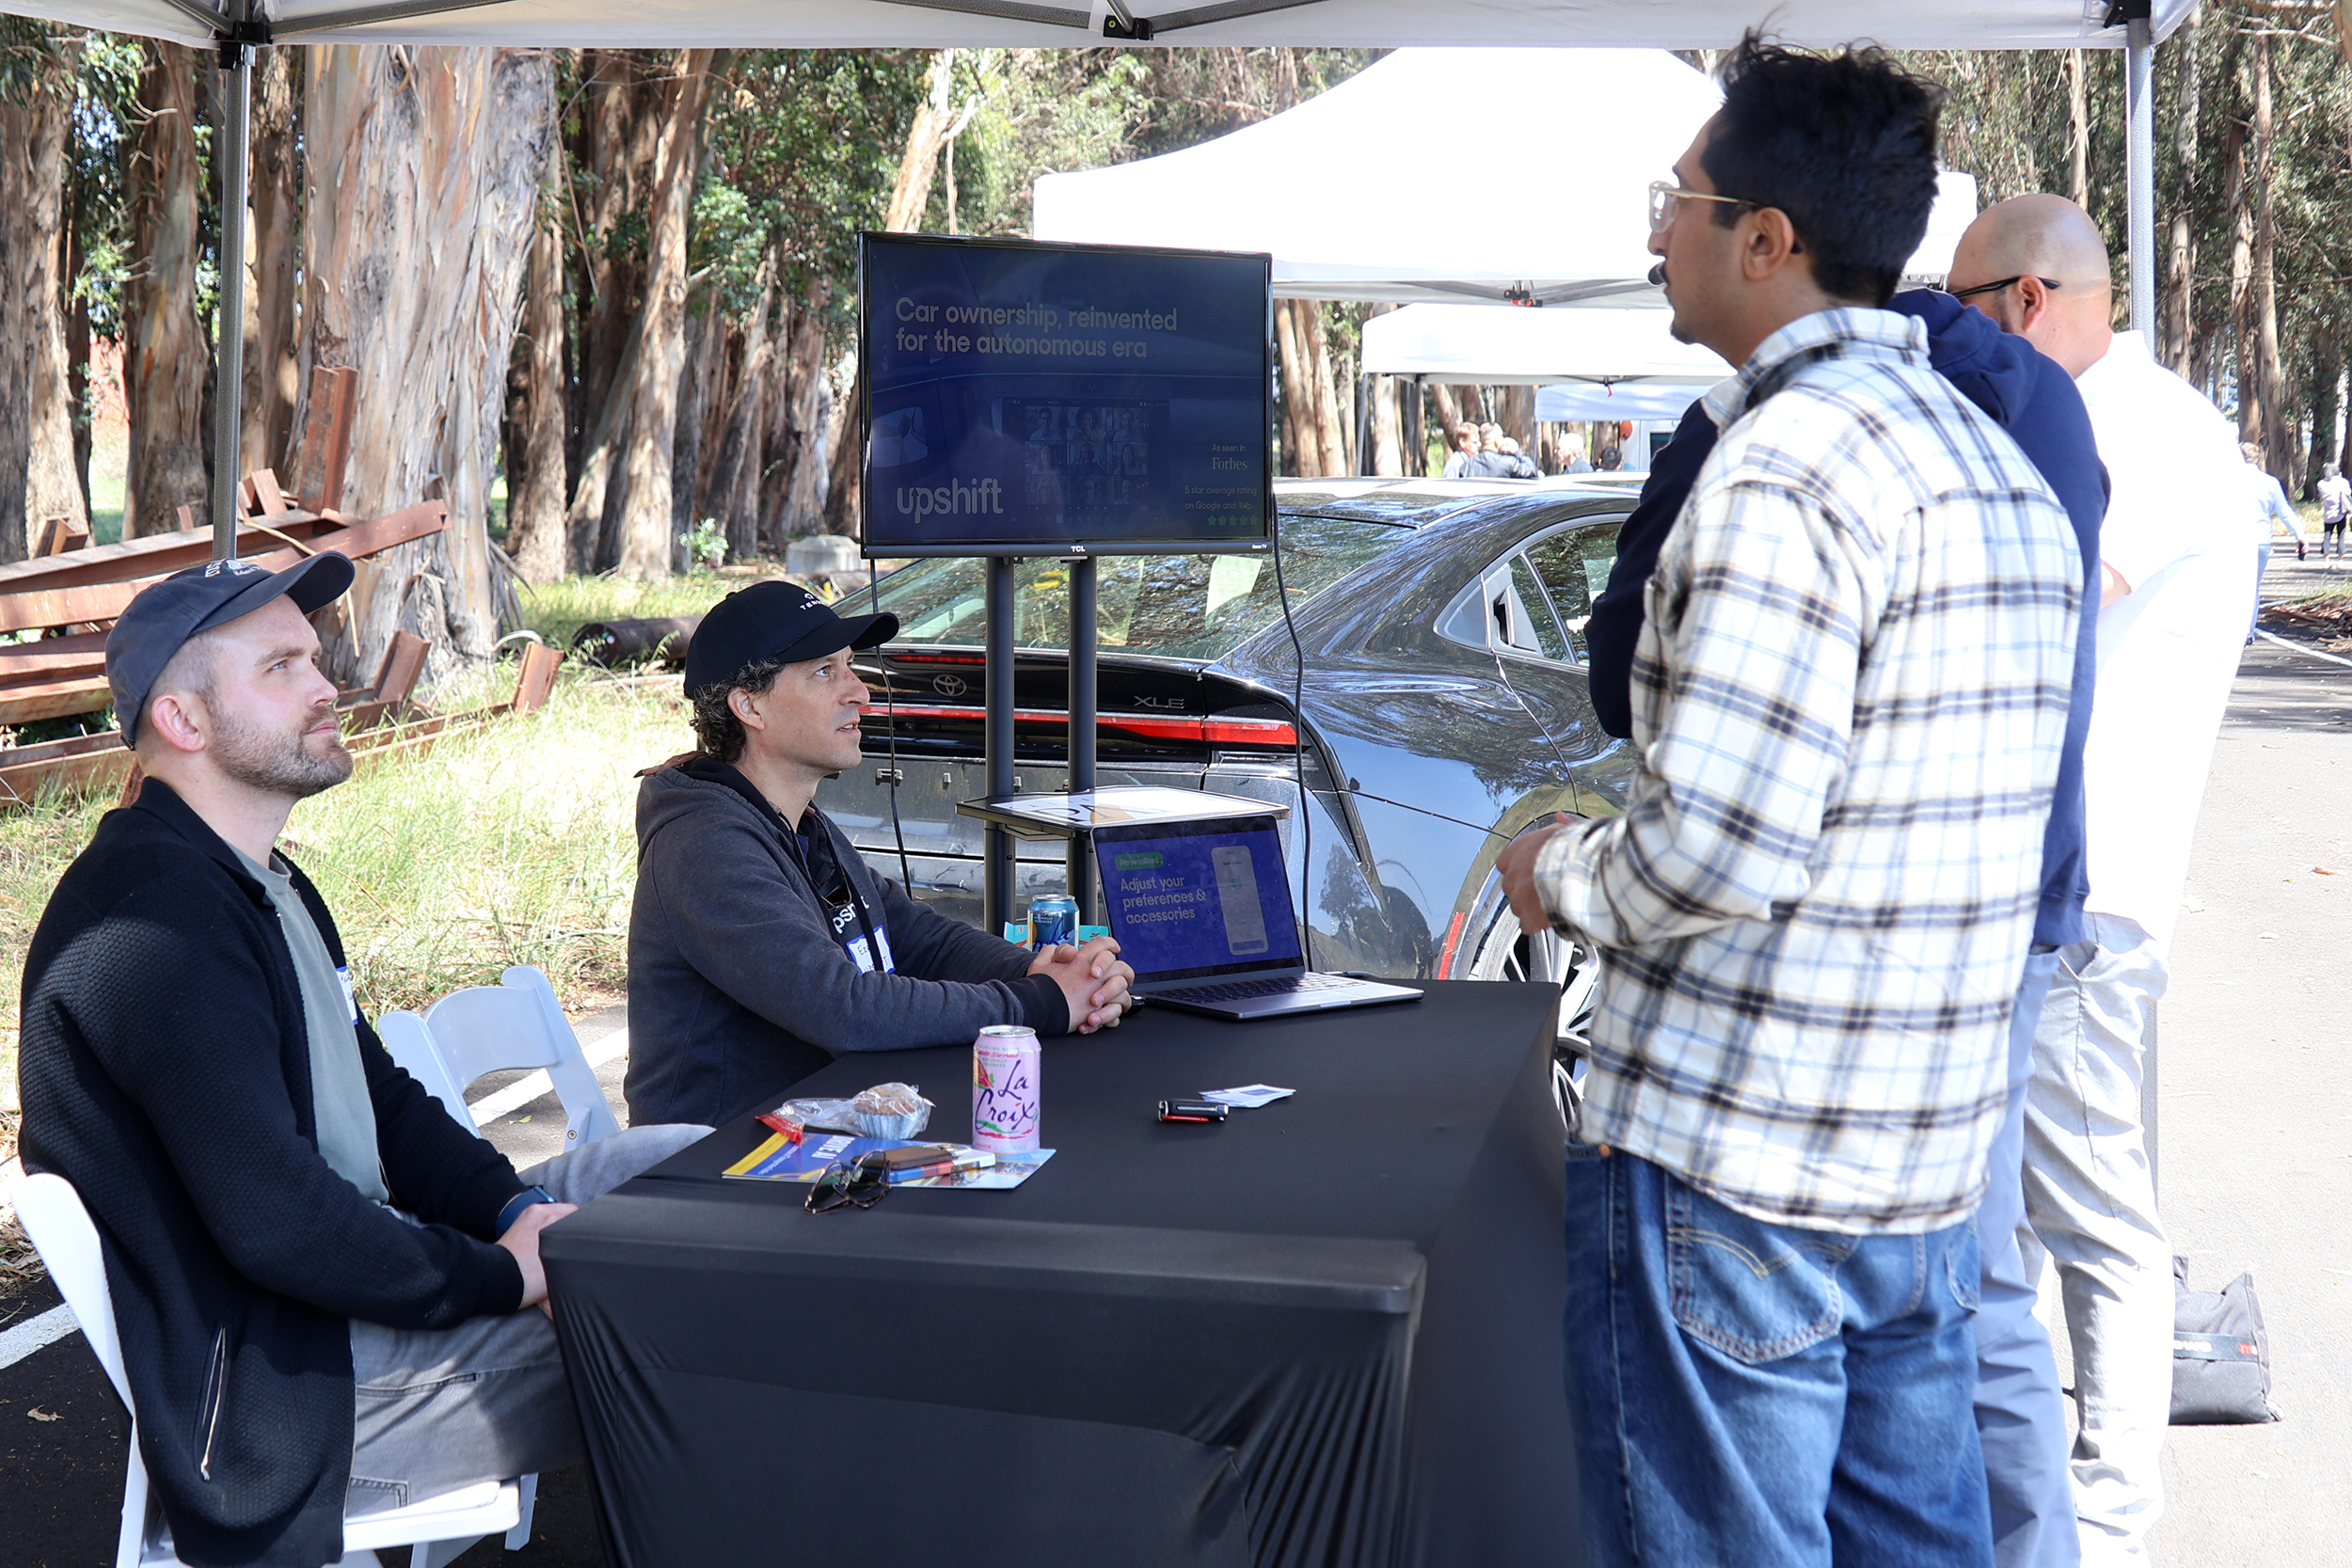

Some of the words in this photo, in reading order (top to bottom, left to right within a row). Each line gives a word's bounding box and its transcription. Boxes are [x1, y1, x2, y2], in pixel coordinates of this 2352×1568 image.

[896, 297, 939, 323] Car
[946, 302, 1062, 333] ownership,
[1068, 305, 1177, 331] reinvented
[896, 327, 928, 351] for
[934, 328, 971, 353] the
[977, 333, 1106, 356] autonomous
[1112, 340, 1147, 357] era
[1212, 457, 1248, 470] Forbes
[1184, 485, 1190, 494] 5
[1206, 487, 1235, 497] average
[1236, 486, 1258, 497] rating
[897, 478, 1004, 524] upshift
[1196, 501, 1221, 511] Google
[1222, 501, 1236, 510] and
[1071, 545, 1086, 553] TCL
[1134, 696, 1184, 709] XLE
[1120, 877, 1156, 894] Adjust
[1159, 877, 1184, 892] your
[1122, 893, 1194, 911] preferences
[1196, 888, 1207, 902] &
[1126, 907, 1196, 925] accessories
[997, 1059, 1029, 1101] La
[975, 1088, 1035, 1131] Croix
